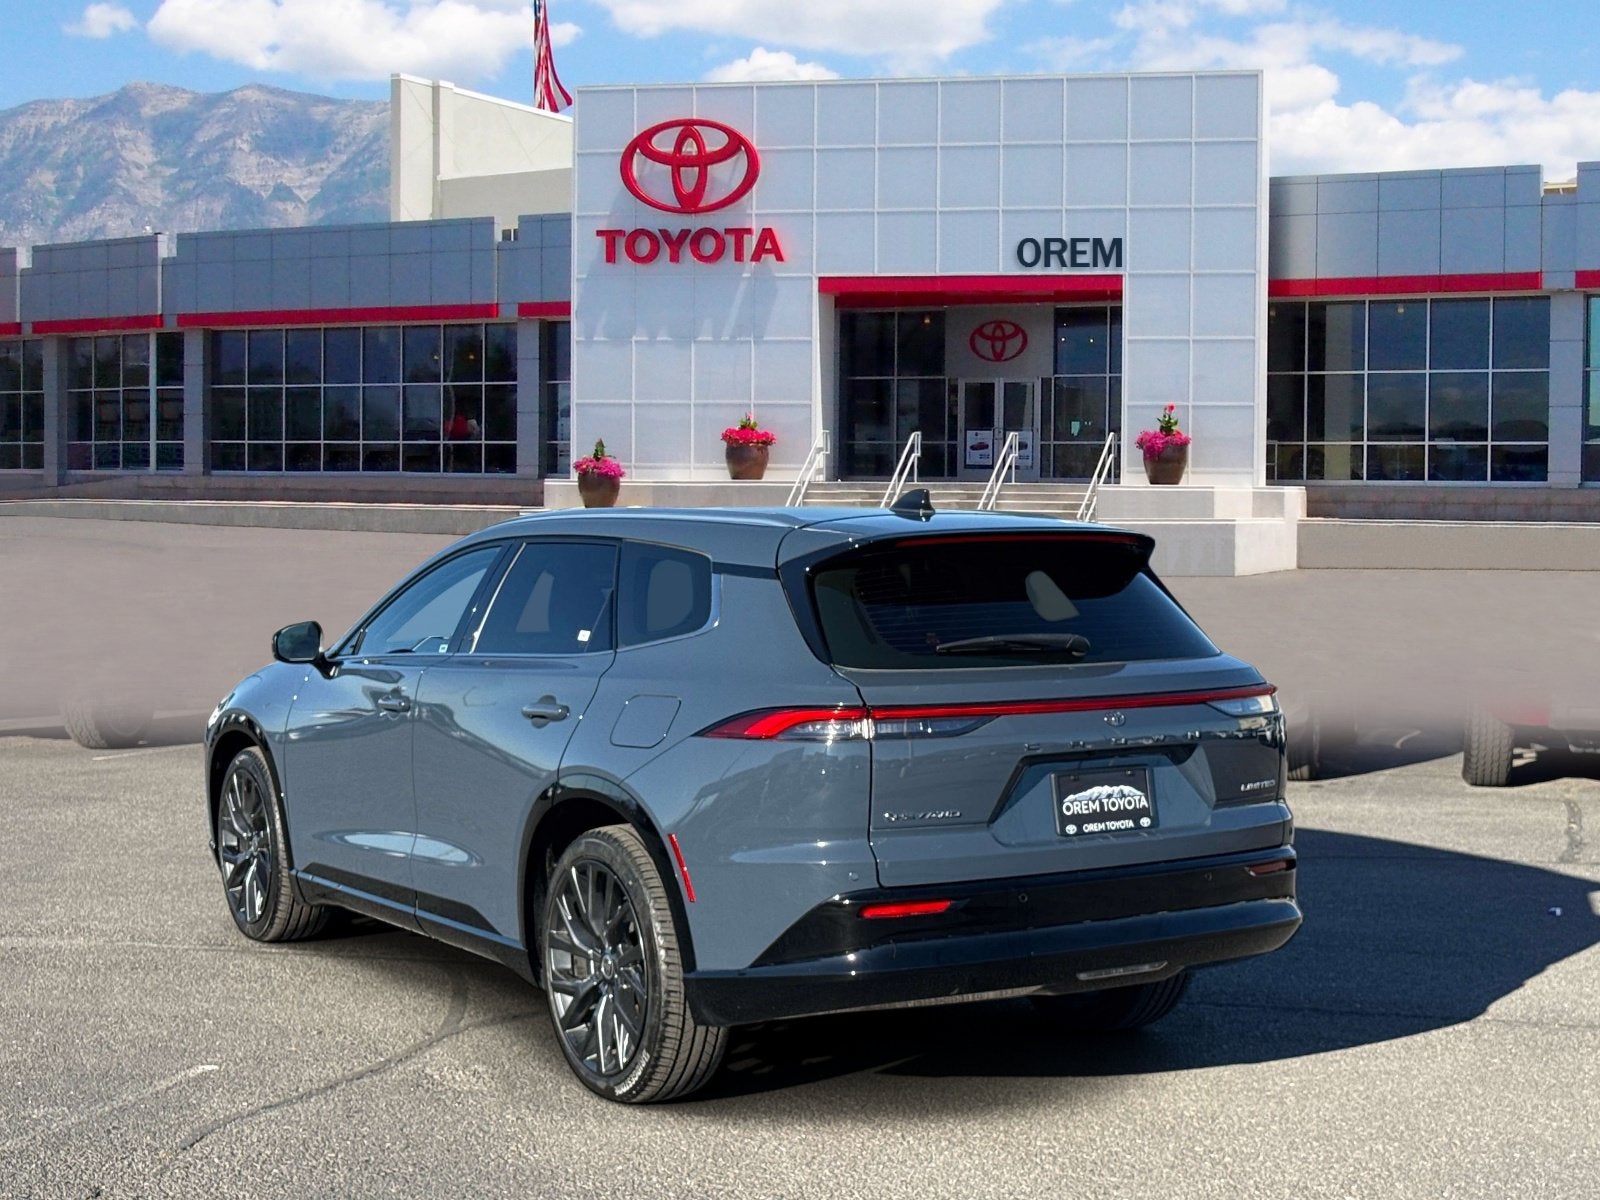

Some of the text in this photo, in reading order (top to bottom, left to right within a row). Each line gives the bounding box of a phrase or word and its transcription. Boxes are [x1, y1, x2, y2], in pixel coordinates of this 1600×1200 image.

[596, 227, 785, 264] TOYOTA
[1016, 237, 1123, 268] OREM
[1062, 795, 1149, 816] OREM TOYOTA
[1082, 819, 1134, 833] OREM TOYOTA
